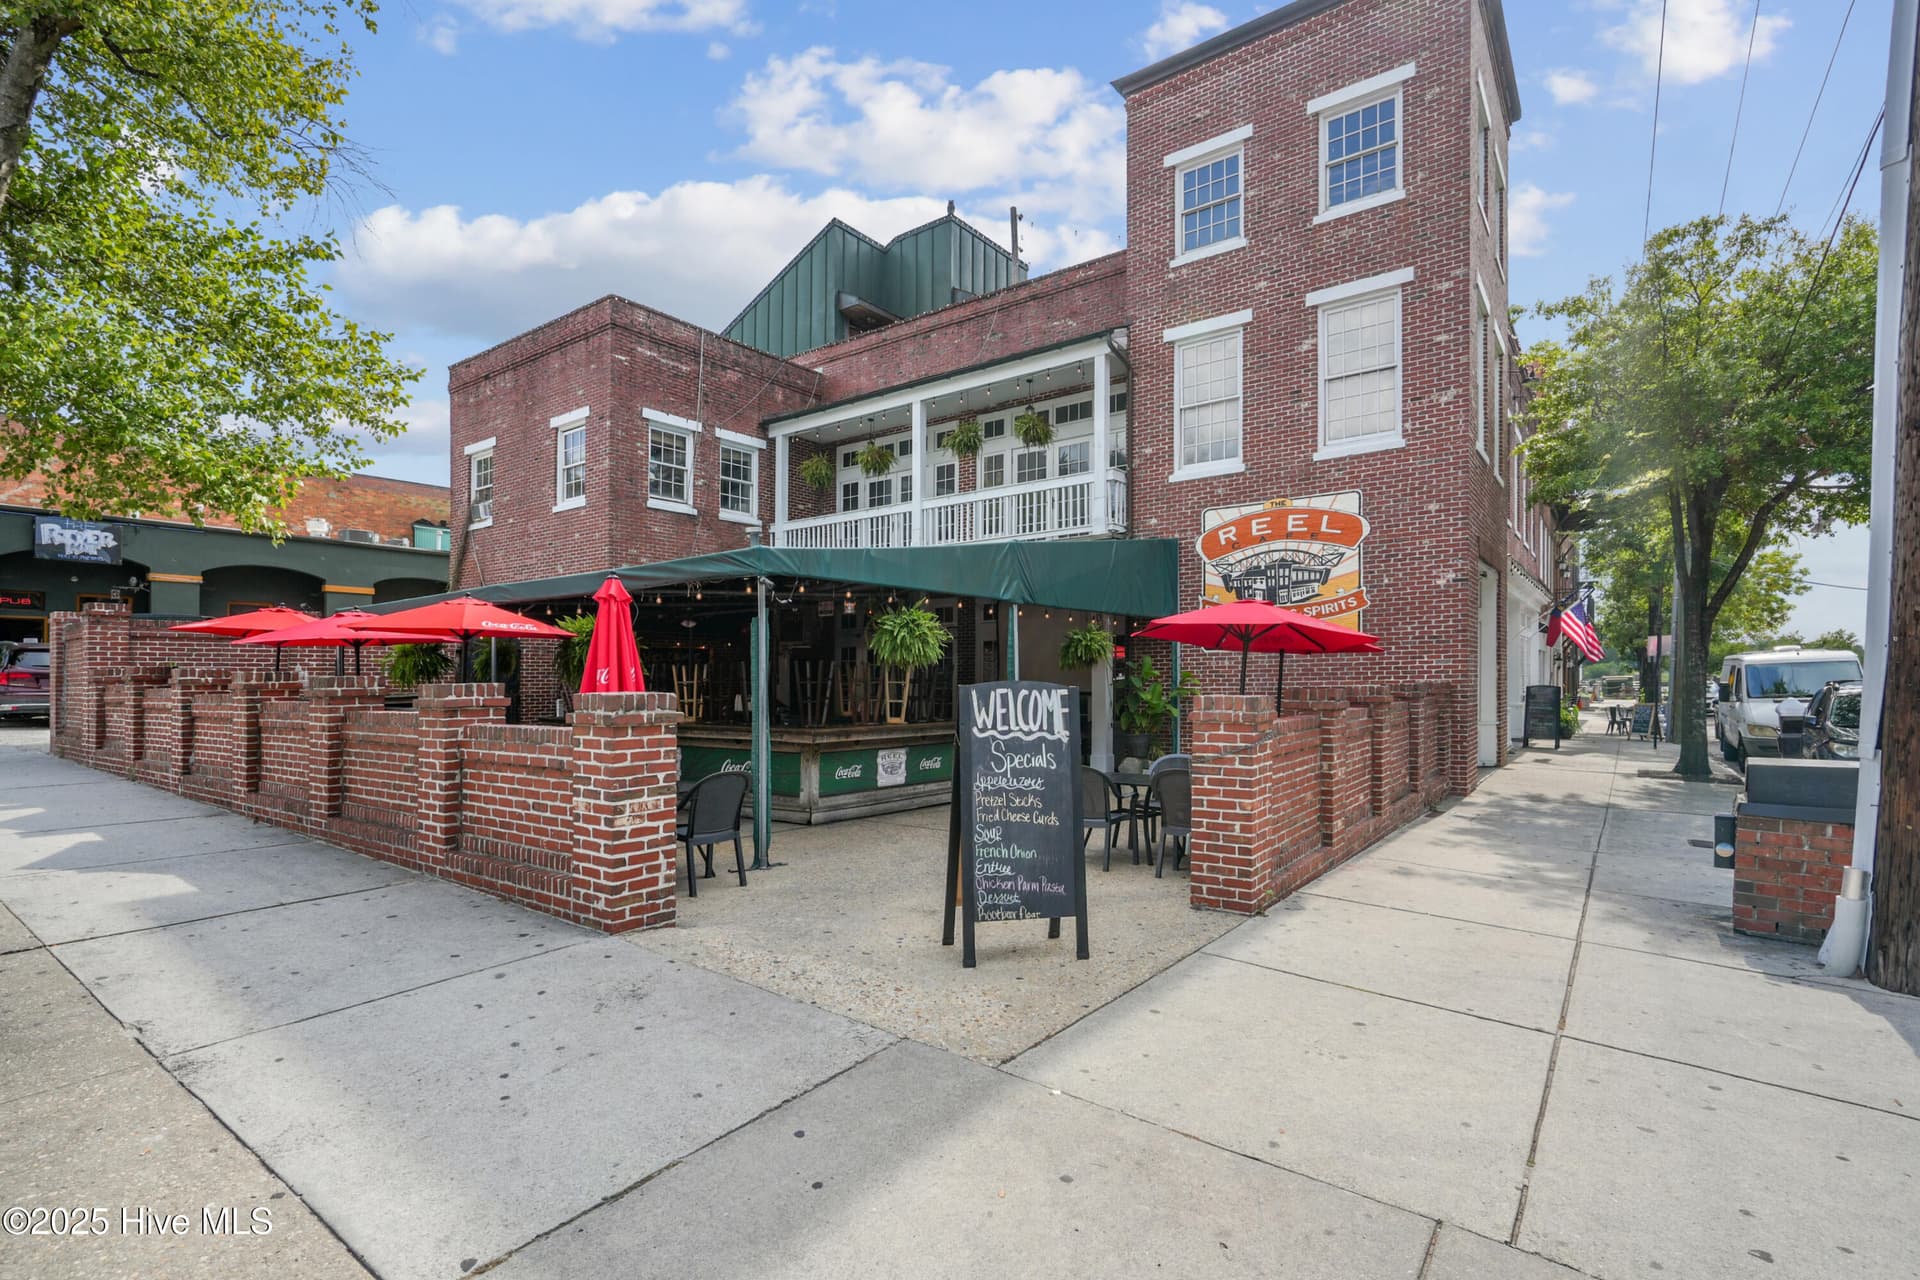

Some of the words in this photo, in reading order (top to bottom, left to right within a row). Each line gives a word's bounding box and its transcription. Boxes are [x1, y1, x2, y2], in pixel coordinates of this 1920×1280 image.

[1218, 514, 1342, 545] REEL
[1232, 532, 1319, 550] CAFE
[0, 596, 31, 605] PUB
[1303, 596, 1358, 617] SPIRITS
[481, 620, 538, 631] Coca-Cola
[971, 688, 1070, 738] WELCOME
[919, 756, 942, 771] Coca-Cola
[990, 740, 1057, 778] Specials
[835, 764, 863, 780] Coca-Cola
[975, 791, 1006, 807] Pretzel
[976, 806, 1000, 822] Fried
[1001, 808, 1031, 823] Cheese
[1033, 811, 1060, 826] Curds
[975, 843, 1008, 858] French
[1010, 843, 1038, 859] Onion
[975, 876, 1015, 890] Chicken
[1017, 874, 1039, 892] Parm
